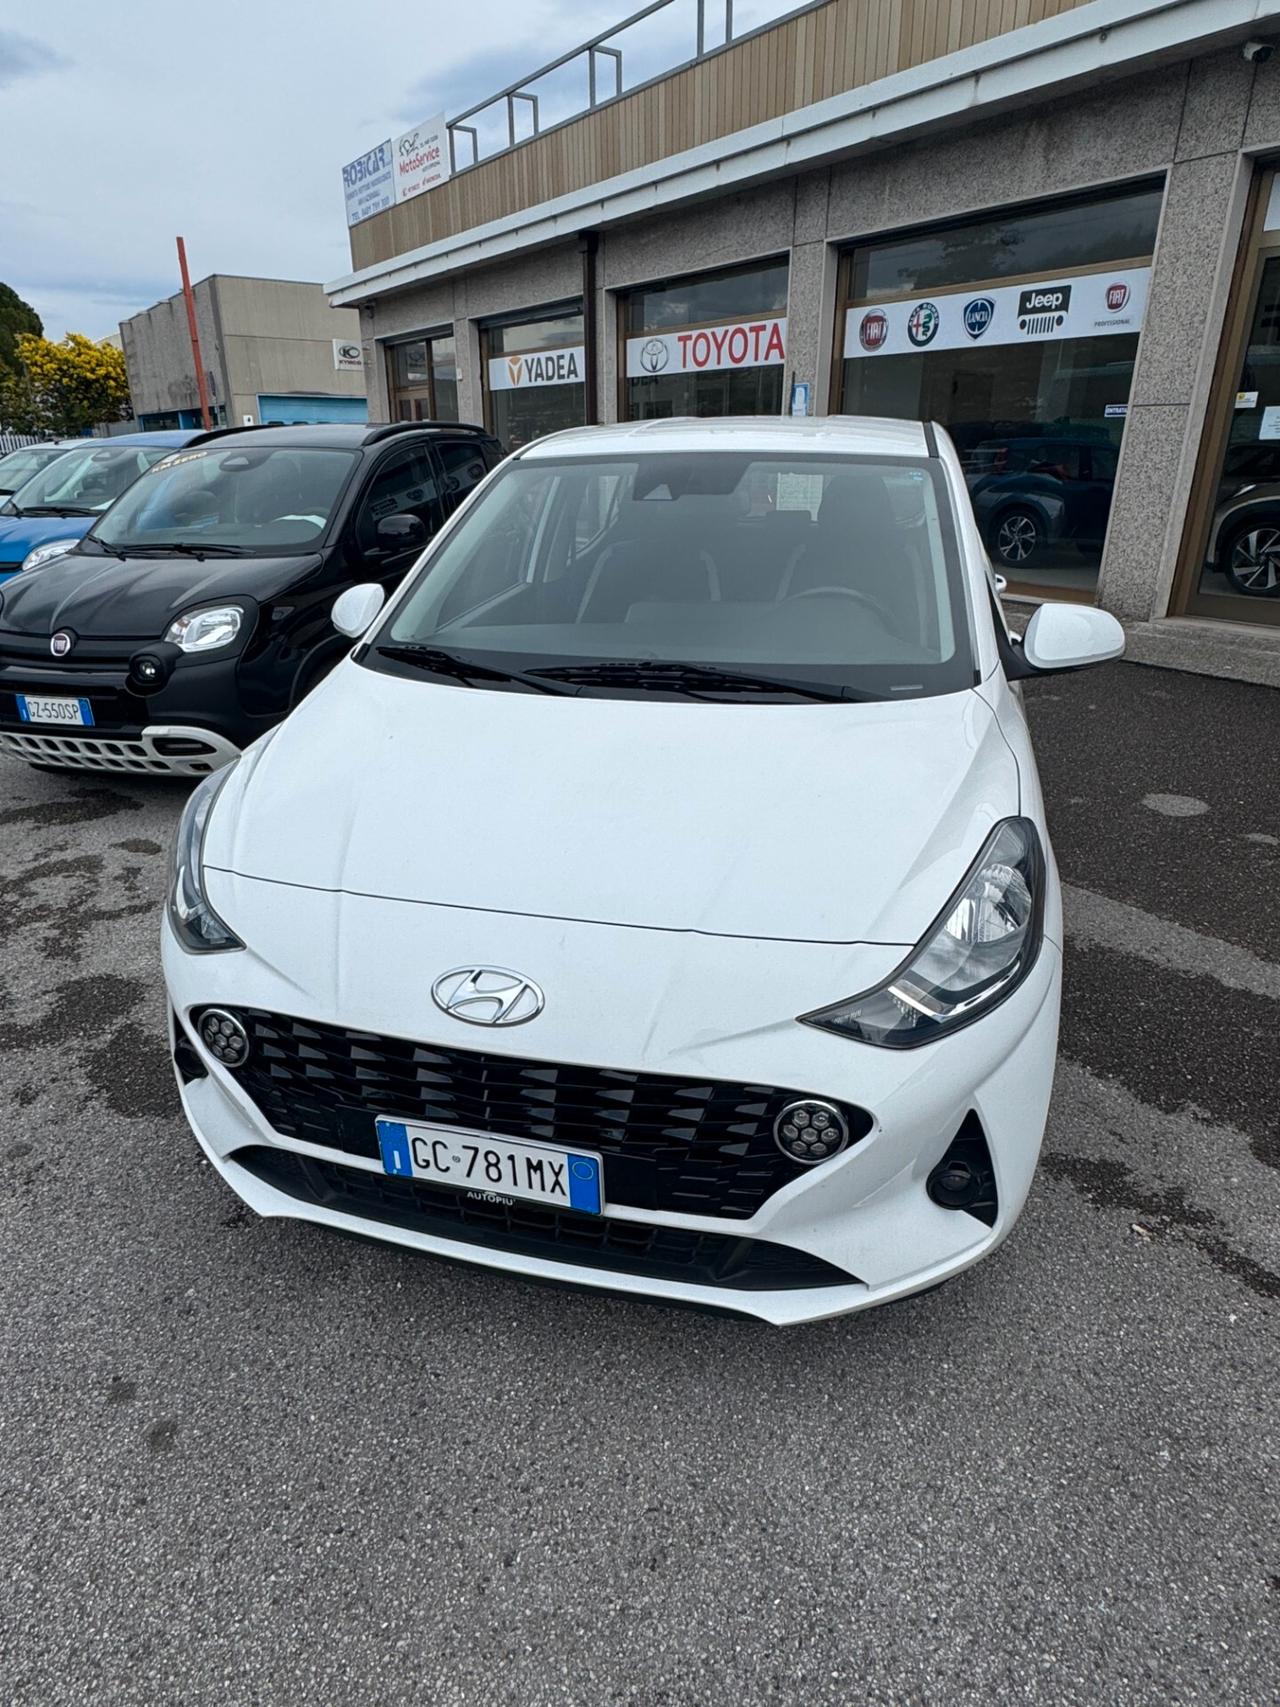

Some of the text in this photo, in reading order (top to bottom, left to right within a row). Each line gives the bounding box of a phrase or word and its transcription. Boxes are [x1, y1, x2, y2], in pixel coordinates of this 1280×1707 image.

[399, 145, 440, 176] MotoService
[1025, 292, 1063, 309] Jeep
[1108, 289, 1125, 305] FIAT
[866, 321, 883, 341] FIAT
[678, 322, 785, 369] TOYOTA
[524, 353, 579, 383] YADEA
